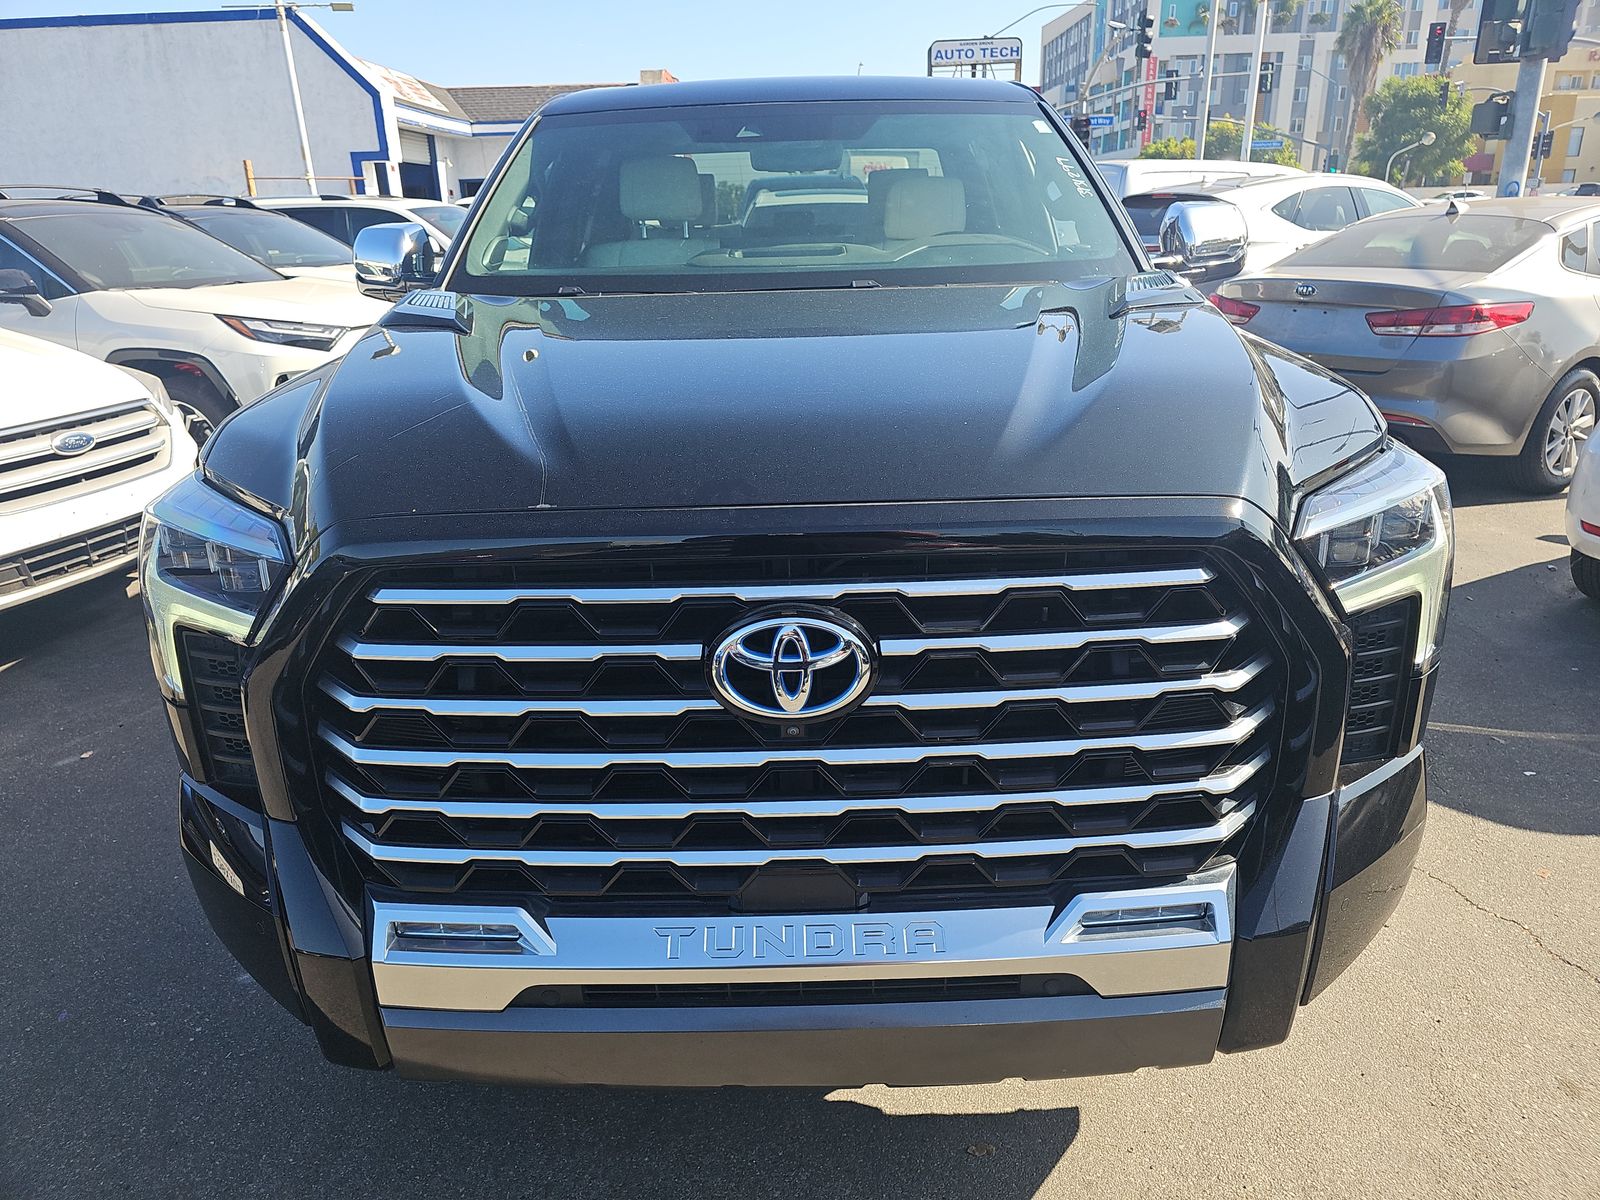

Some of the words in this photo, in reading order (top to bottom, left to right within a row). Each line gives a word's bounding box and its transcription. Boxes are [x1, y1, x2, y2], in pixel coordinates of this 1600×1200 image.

[934, 48, 975, 60] AUTO
[980, 46, 1020, 58] TECH
[1297, 286, 1313, 295] KIA
[65, 436, 88, 448] Ford
[652, 920, 947, 960] TUNDRA
